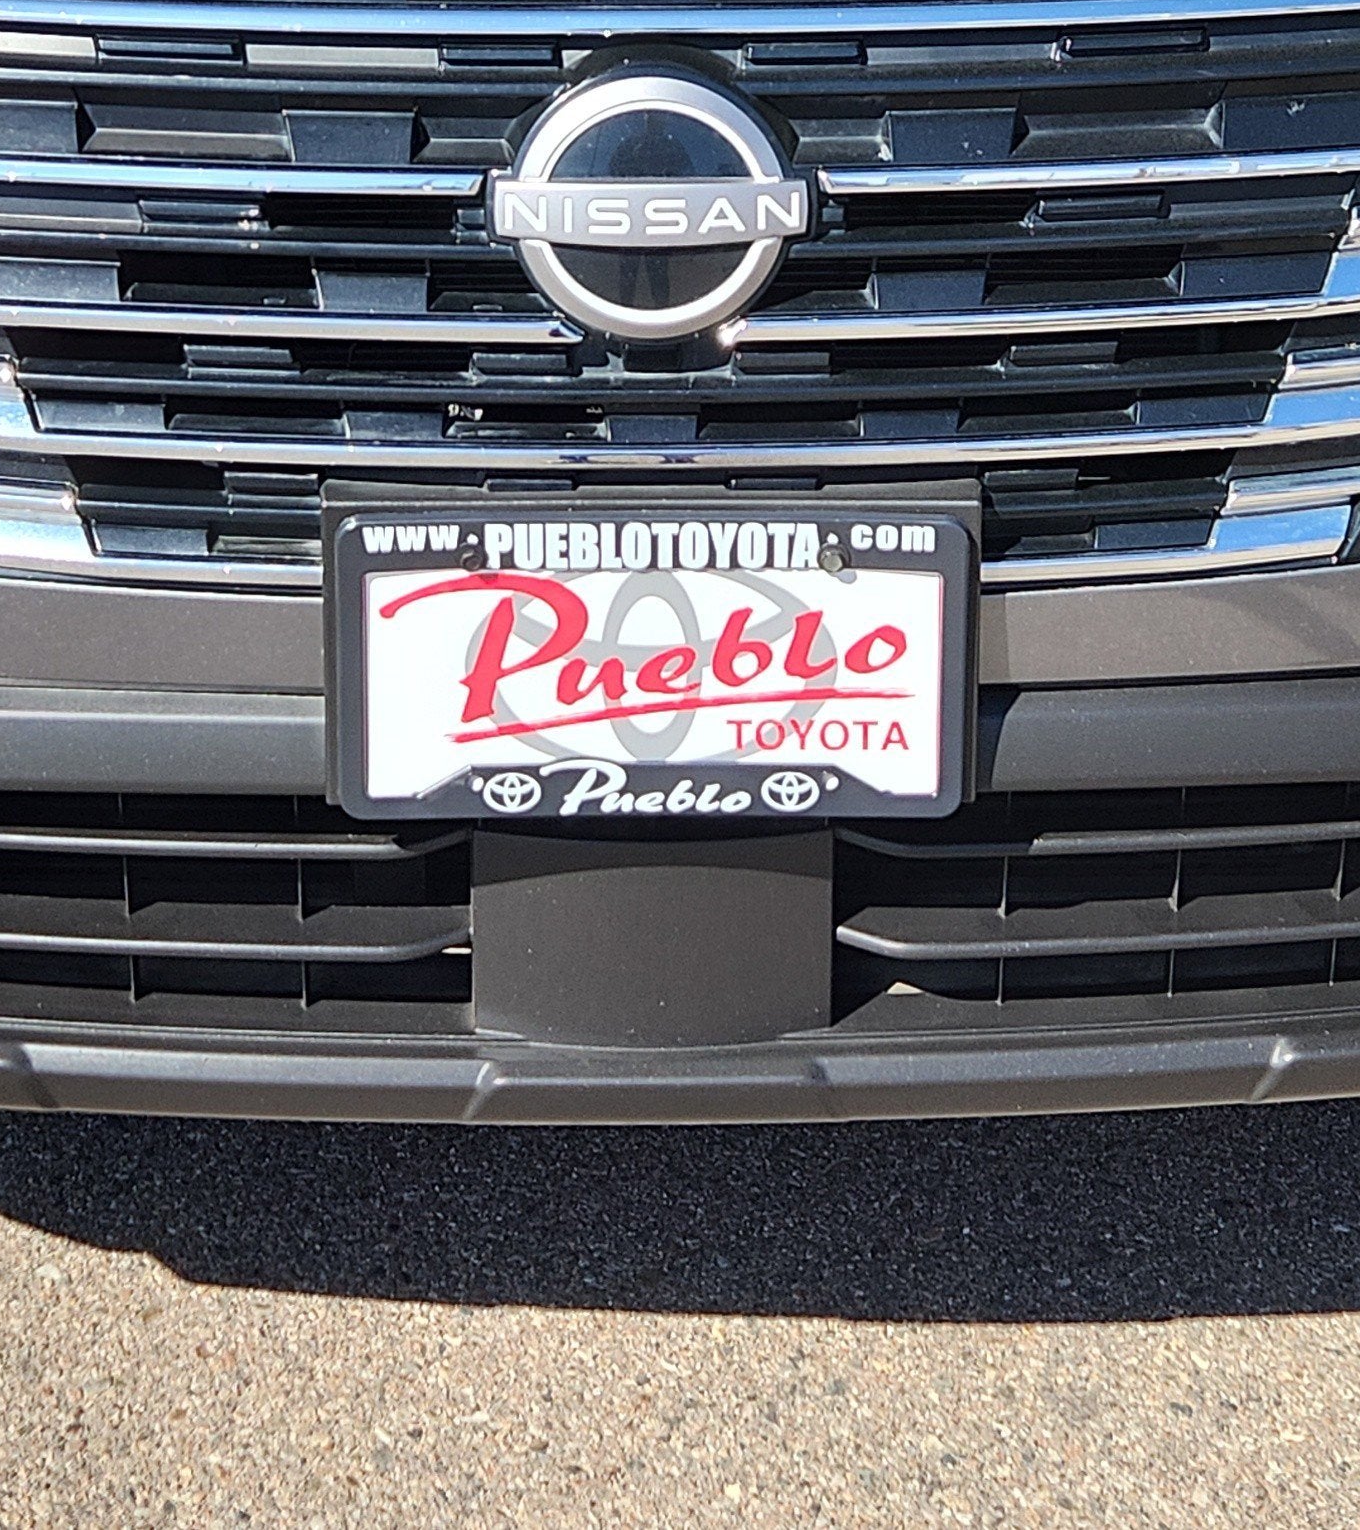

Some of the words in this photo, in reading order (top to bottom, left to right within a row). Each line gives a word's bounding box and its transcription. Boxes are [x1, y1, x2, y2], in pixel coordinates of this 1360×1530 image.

[503, 191, 800, 236] NISSAN
[379, 573, 908, 722] Pueblo
[727, 719, 910, 751] TOYOTA
[540, 759, 752, 816] Pueblo
